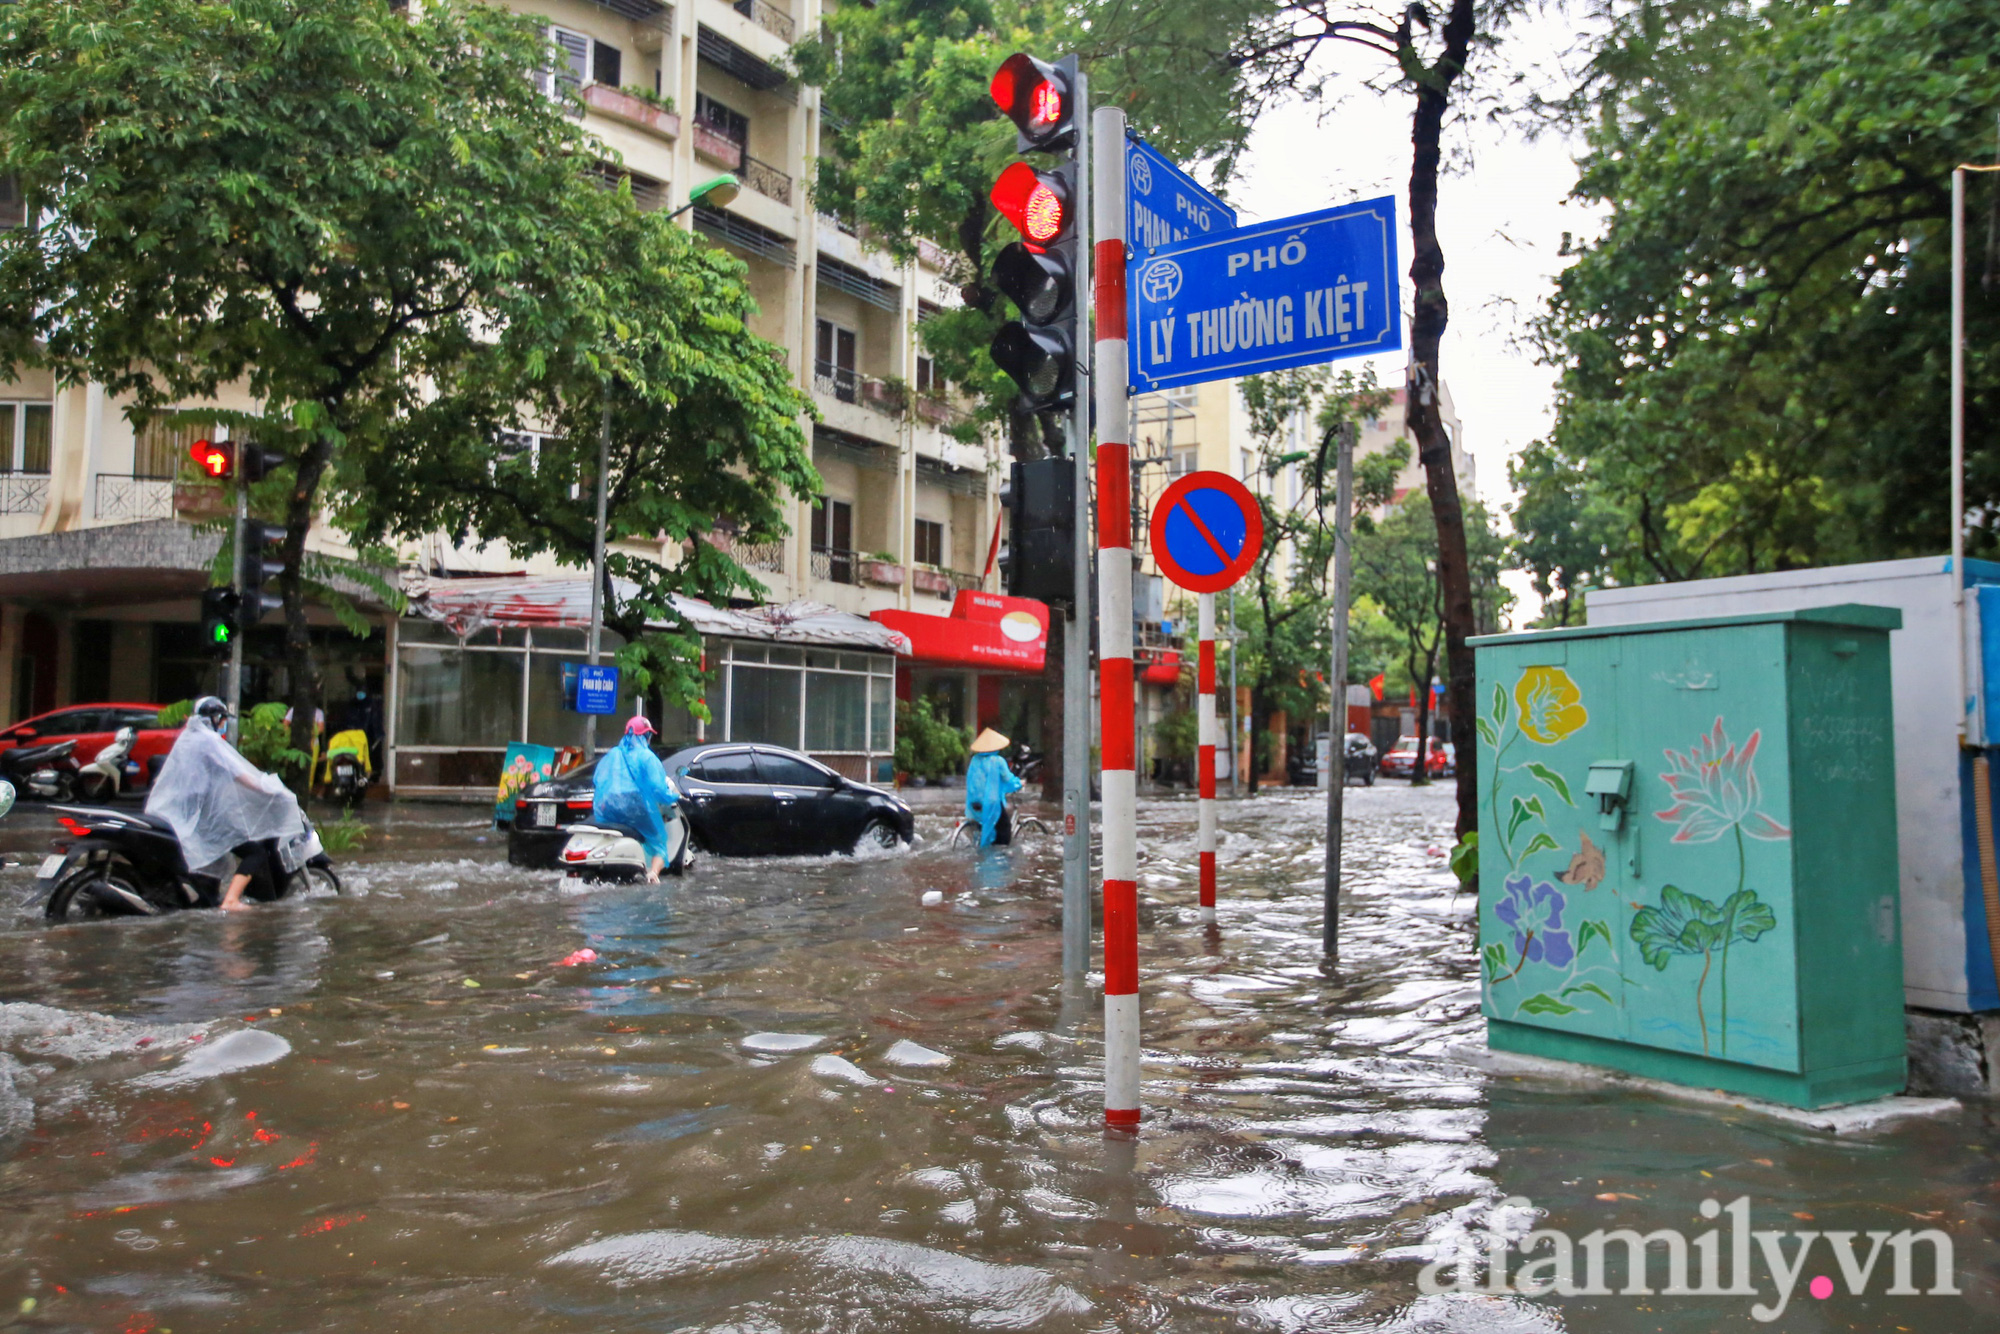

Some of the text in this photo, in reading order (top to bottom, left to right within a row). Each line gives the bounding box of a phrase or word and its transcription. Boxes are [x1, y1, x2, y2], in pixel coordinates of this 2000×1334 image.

[1134, 199, 1171, 248] PHAN
[1176, 192, 1212, 232] PHỐ
[1227, 228, 1309, 277] PHỐ
[1150, 274, 1369, 366] LÝ THƯỜNG KIỆT
